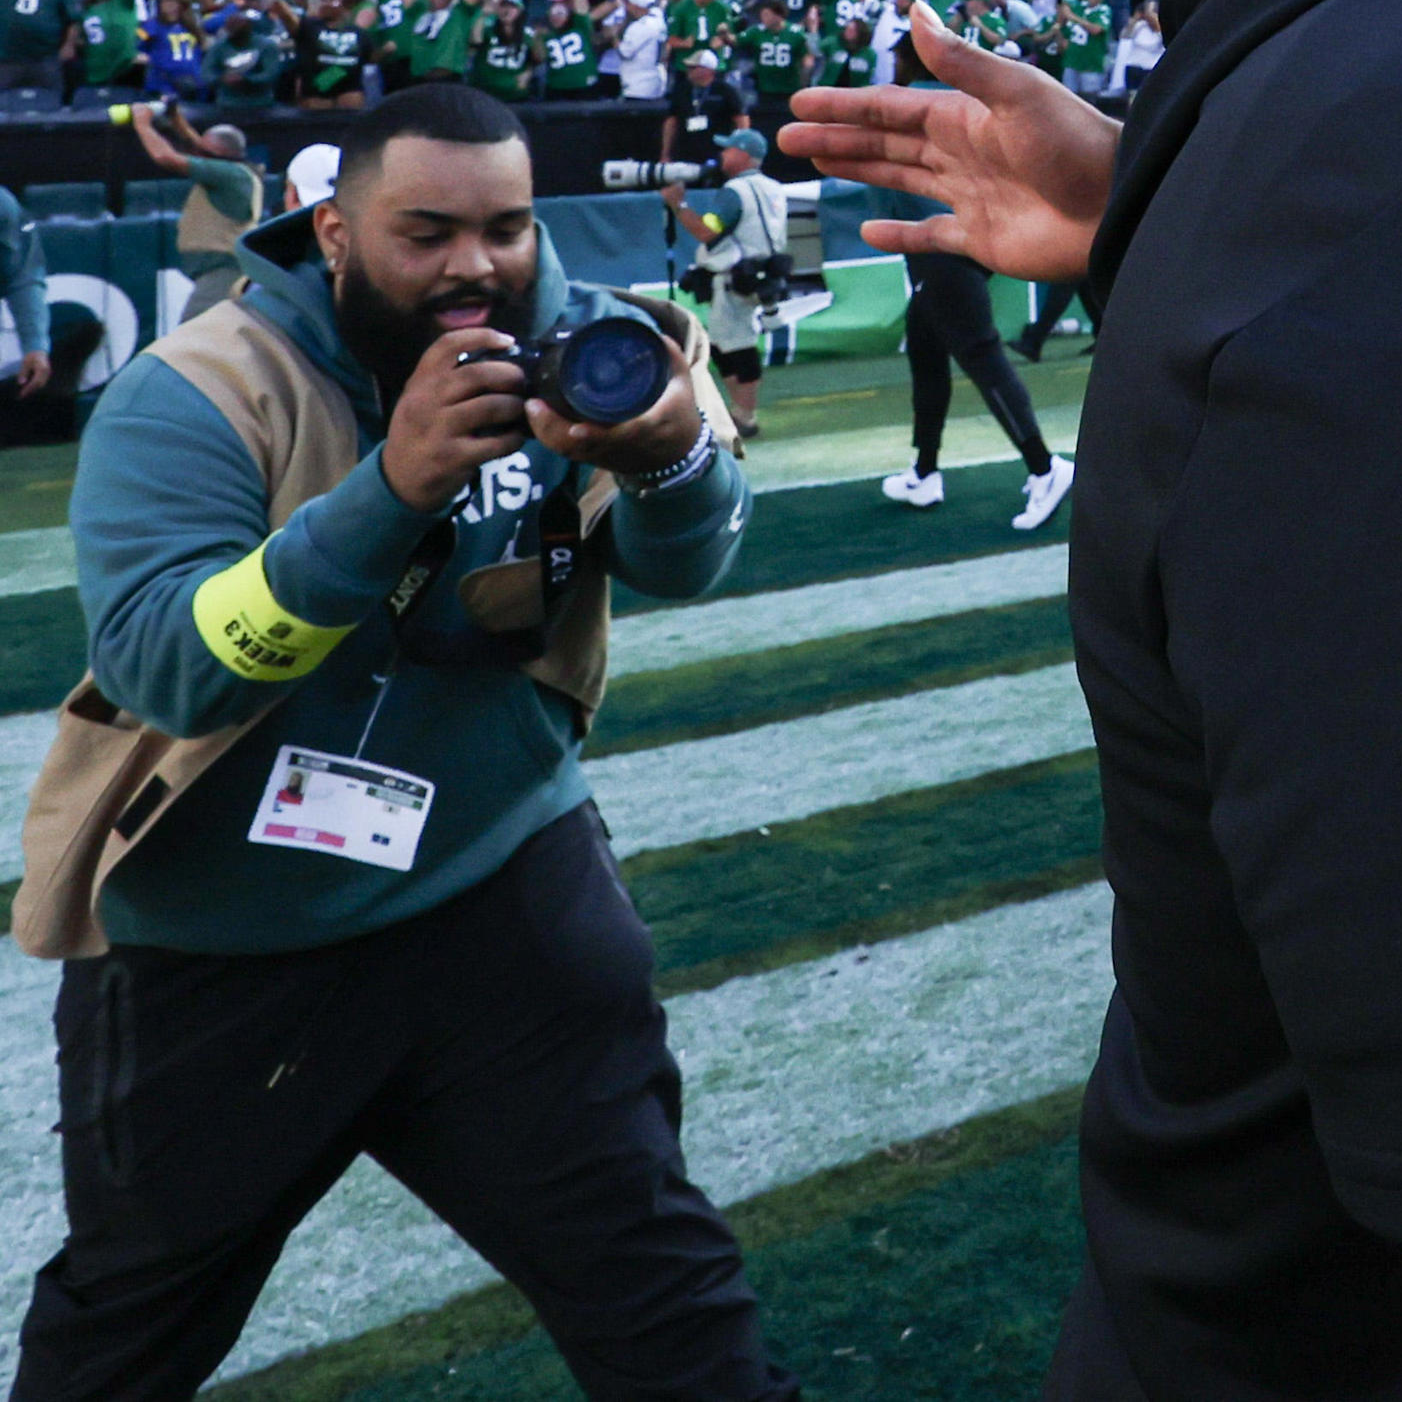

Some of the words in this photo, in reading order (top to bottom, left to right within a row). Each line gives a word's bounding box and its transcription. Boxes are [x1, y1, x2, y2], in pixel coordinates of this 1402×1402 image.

[759, 42, 792, 67] 26
[224, 619, 241, 637] 3
[233, 631, 297, 668] WEEK
